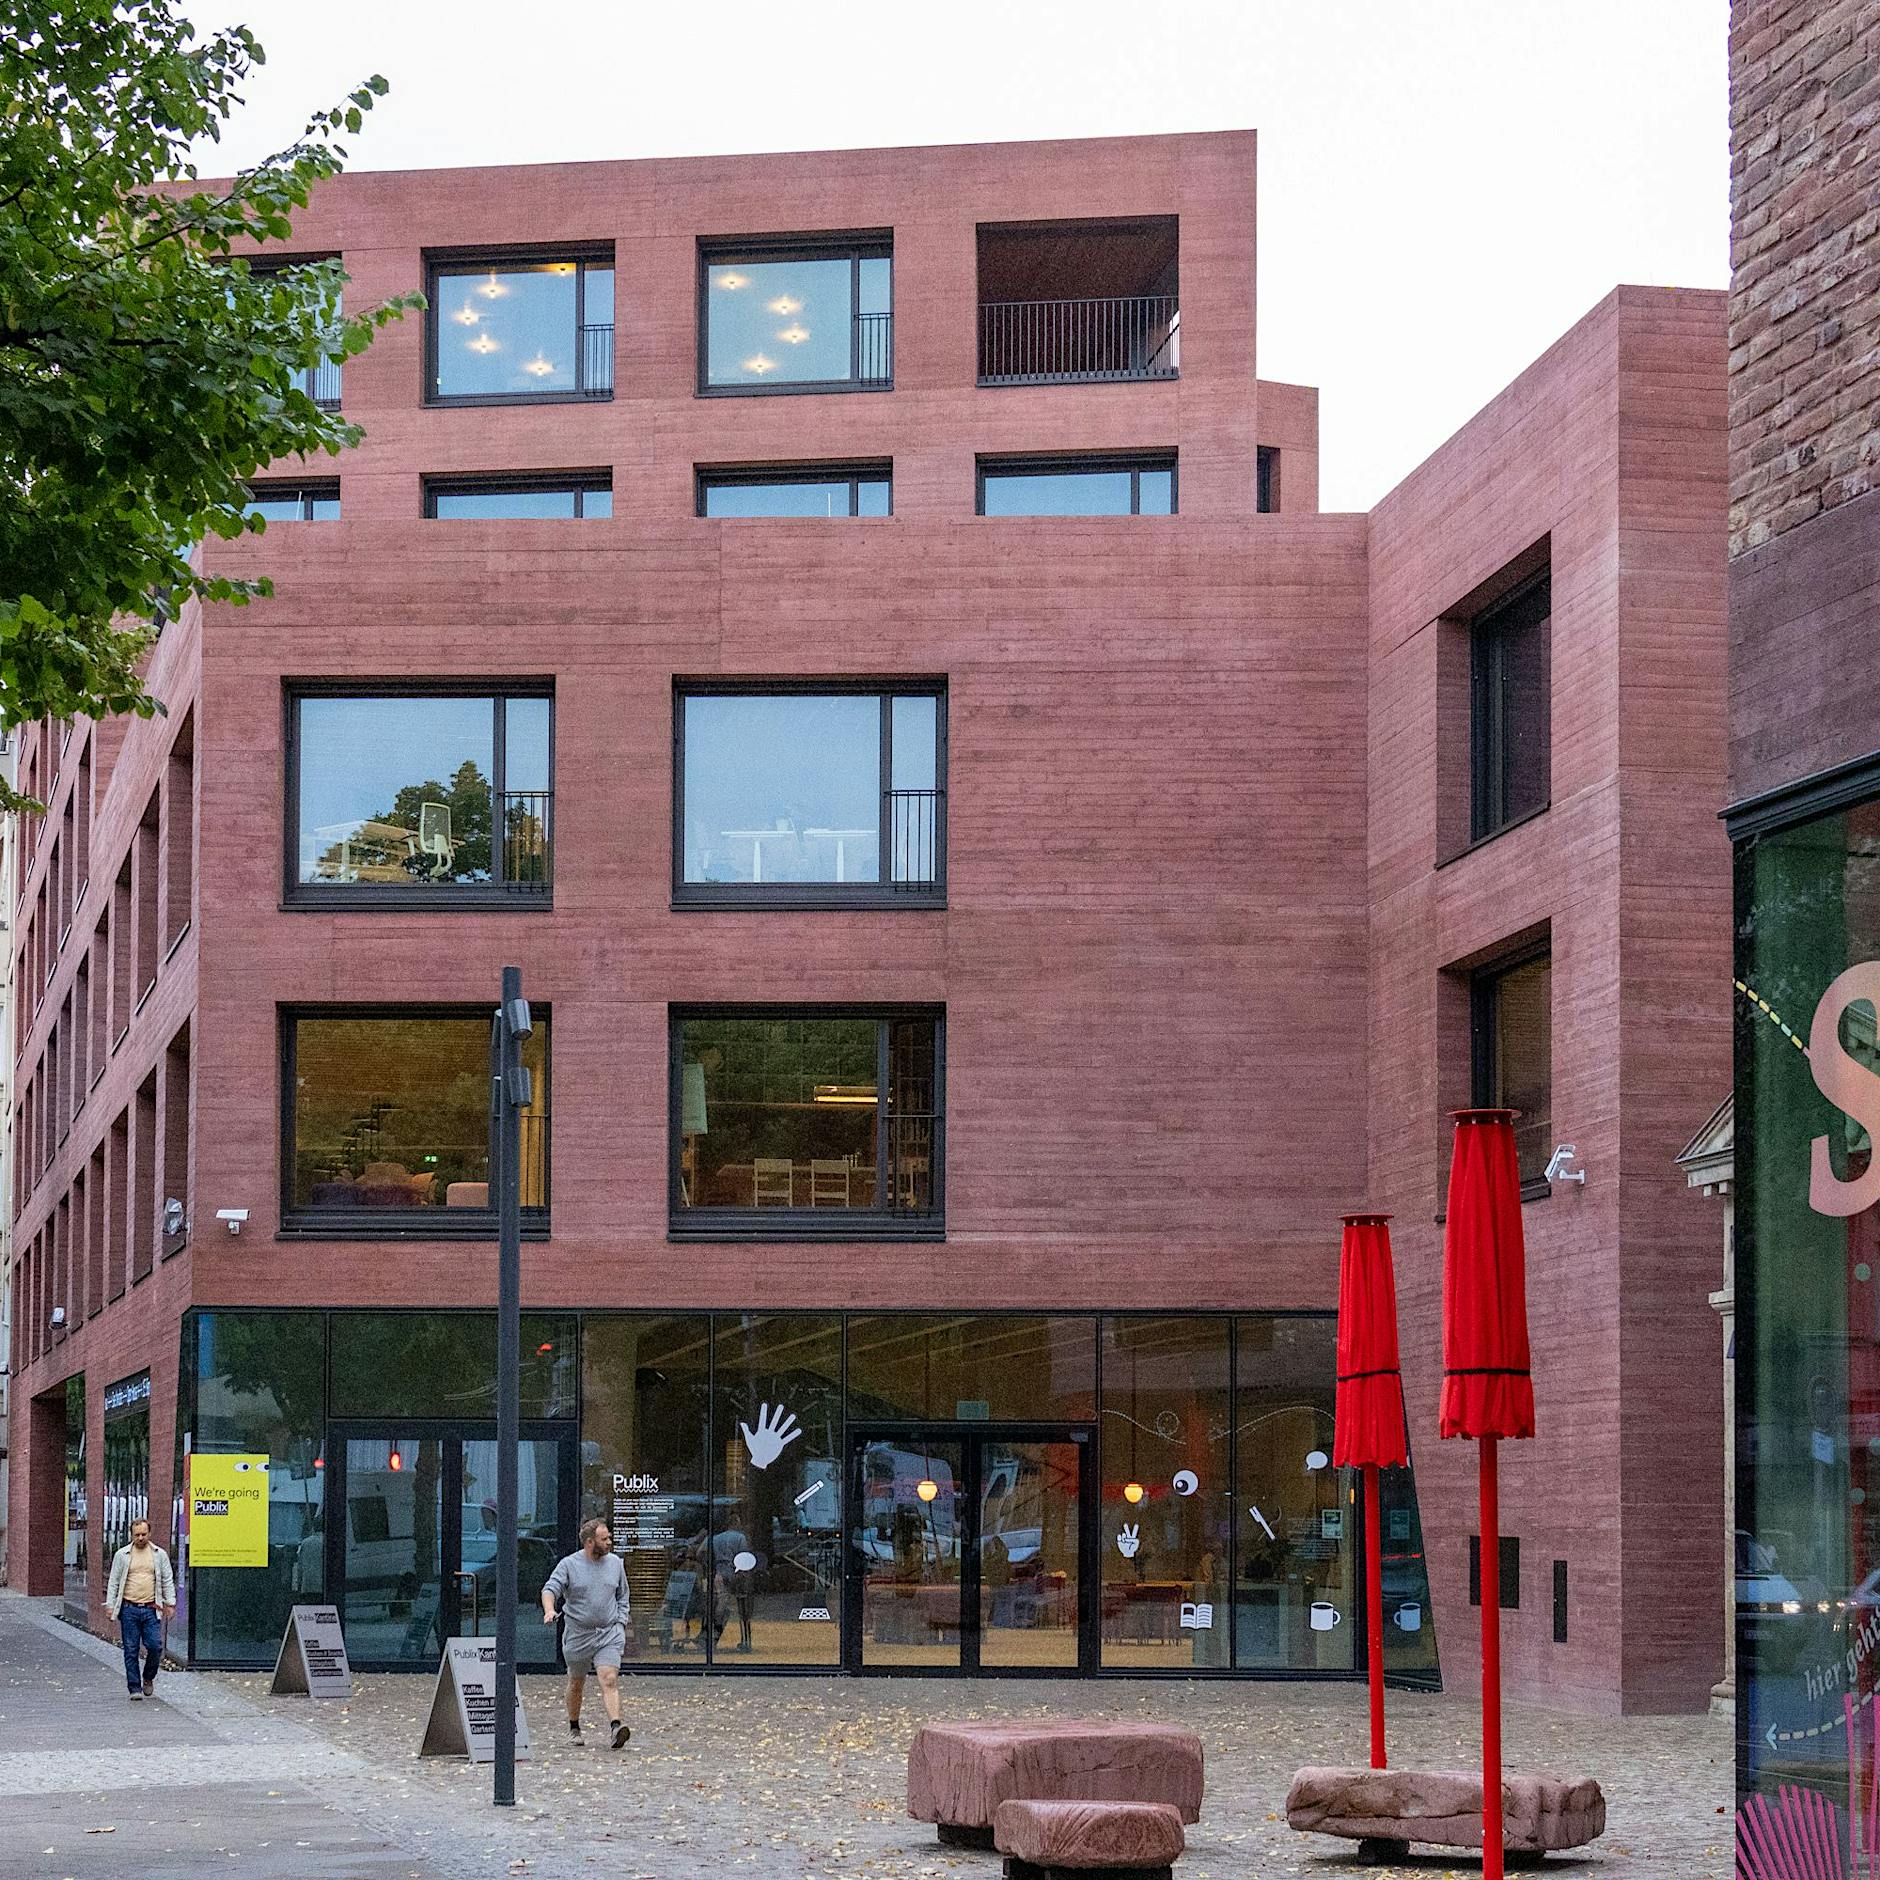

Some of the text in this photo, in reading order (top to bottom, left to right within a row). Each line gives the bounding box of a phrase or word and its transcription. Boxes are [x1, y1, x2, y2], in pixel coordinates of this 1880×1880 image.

[613, 1474, 659, 1489] Publix
[194, 1487, 260, 1500] We're going
[195, 1501, 228, 1512] Publix
[454, 1649, 477, 1659] Publix
[1804, 1662, 1842, 1702] hier
[463, 1686, 484, 1694] Kaffee
[466, 1699, 490, 1707] Kuchen
